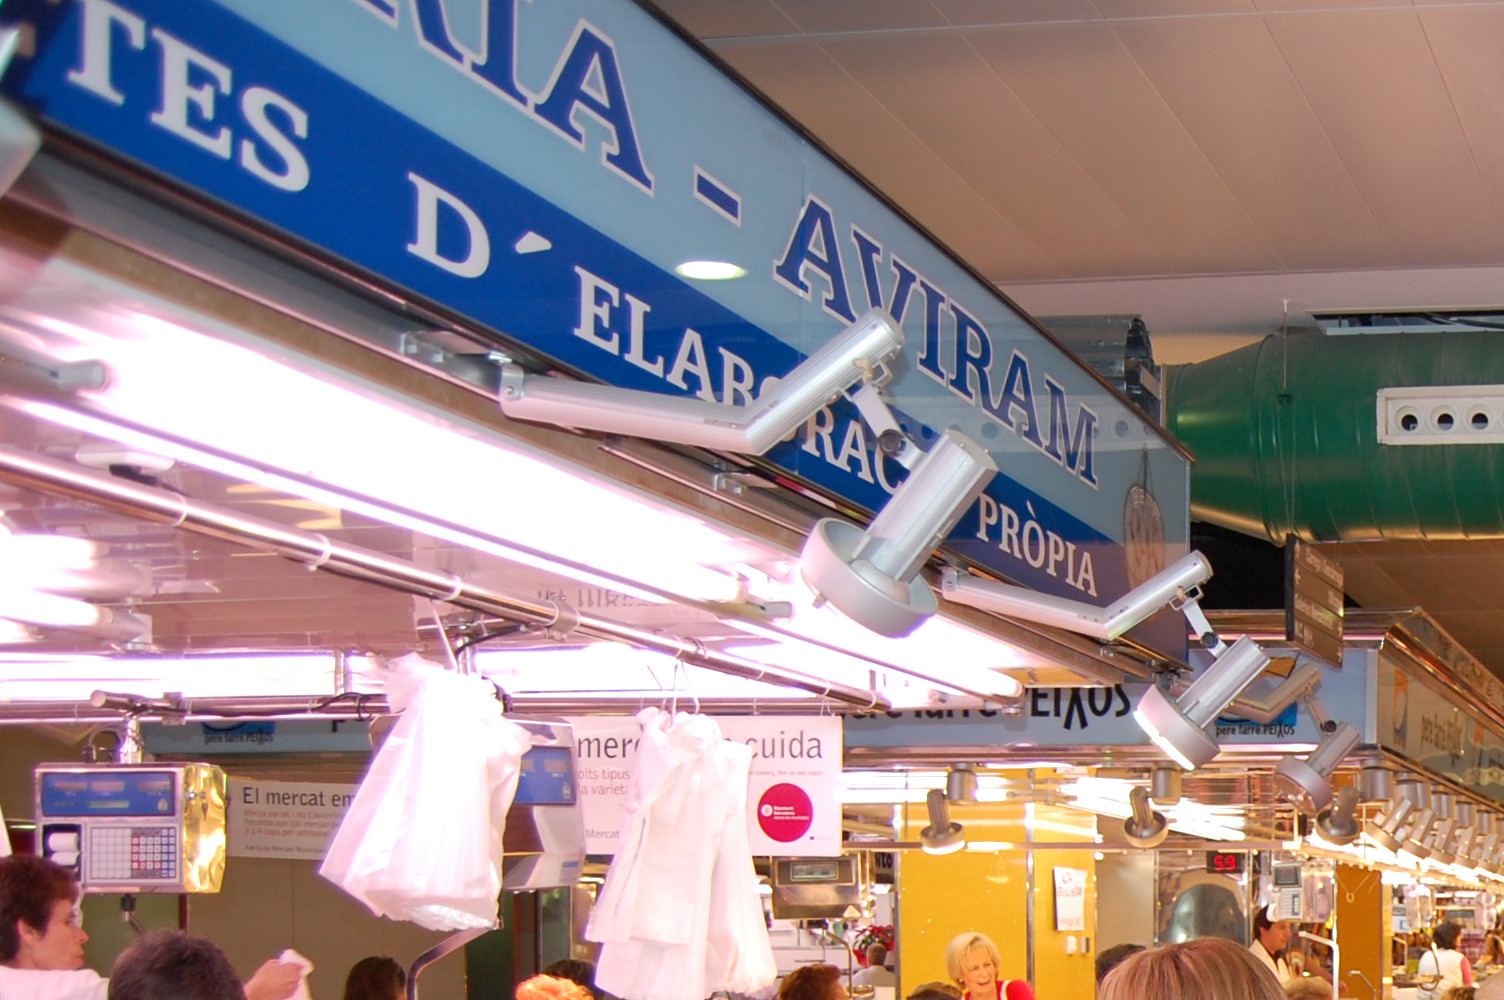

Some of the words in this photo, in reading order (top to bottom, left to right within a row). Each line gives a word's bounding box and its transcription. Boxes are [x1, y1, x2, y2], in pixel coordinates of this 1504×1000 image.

[773, 192, 1099, 490] AVIRAM
[976, 493, 1098, 599] PRÒPIA
[243, 787, 259, 804] El
[266, 791, 325, 807] mercat
[602, 766, 631, 784] tipus
